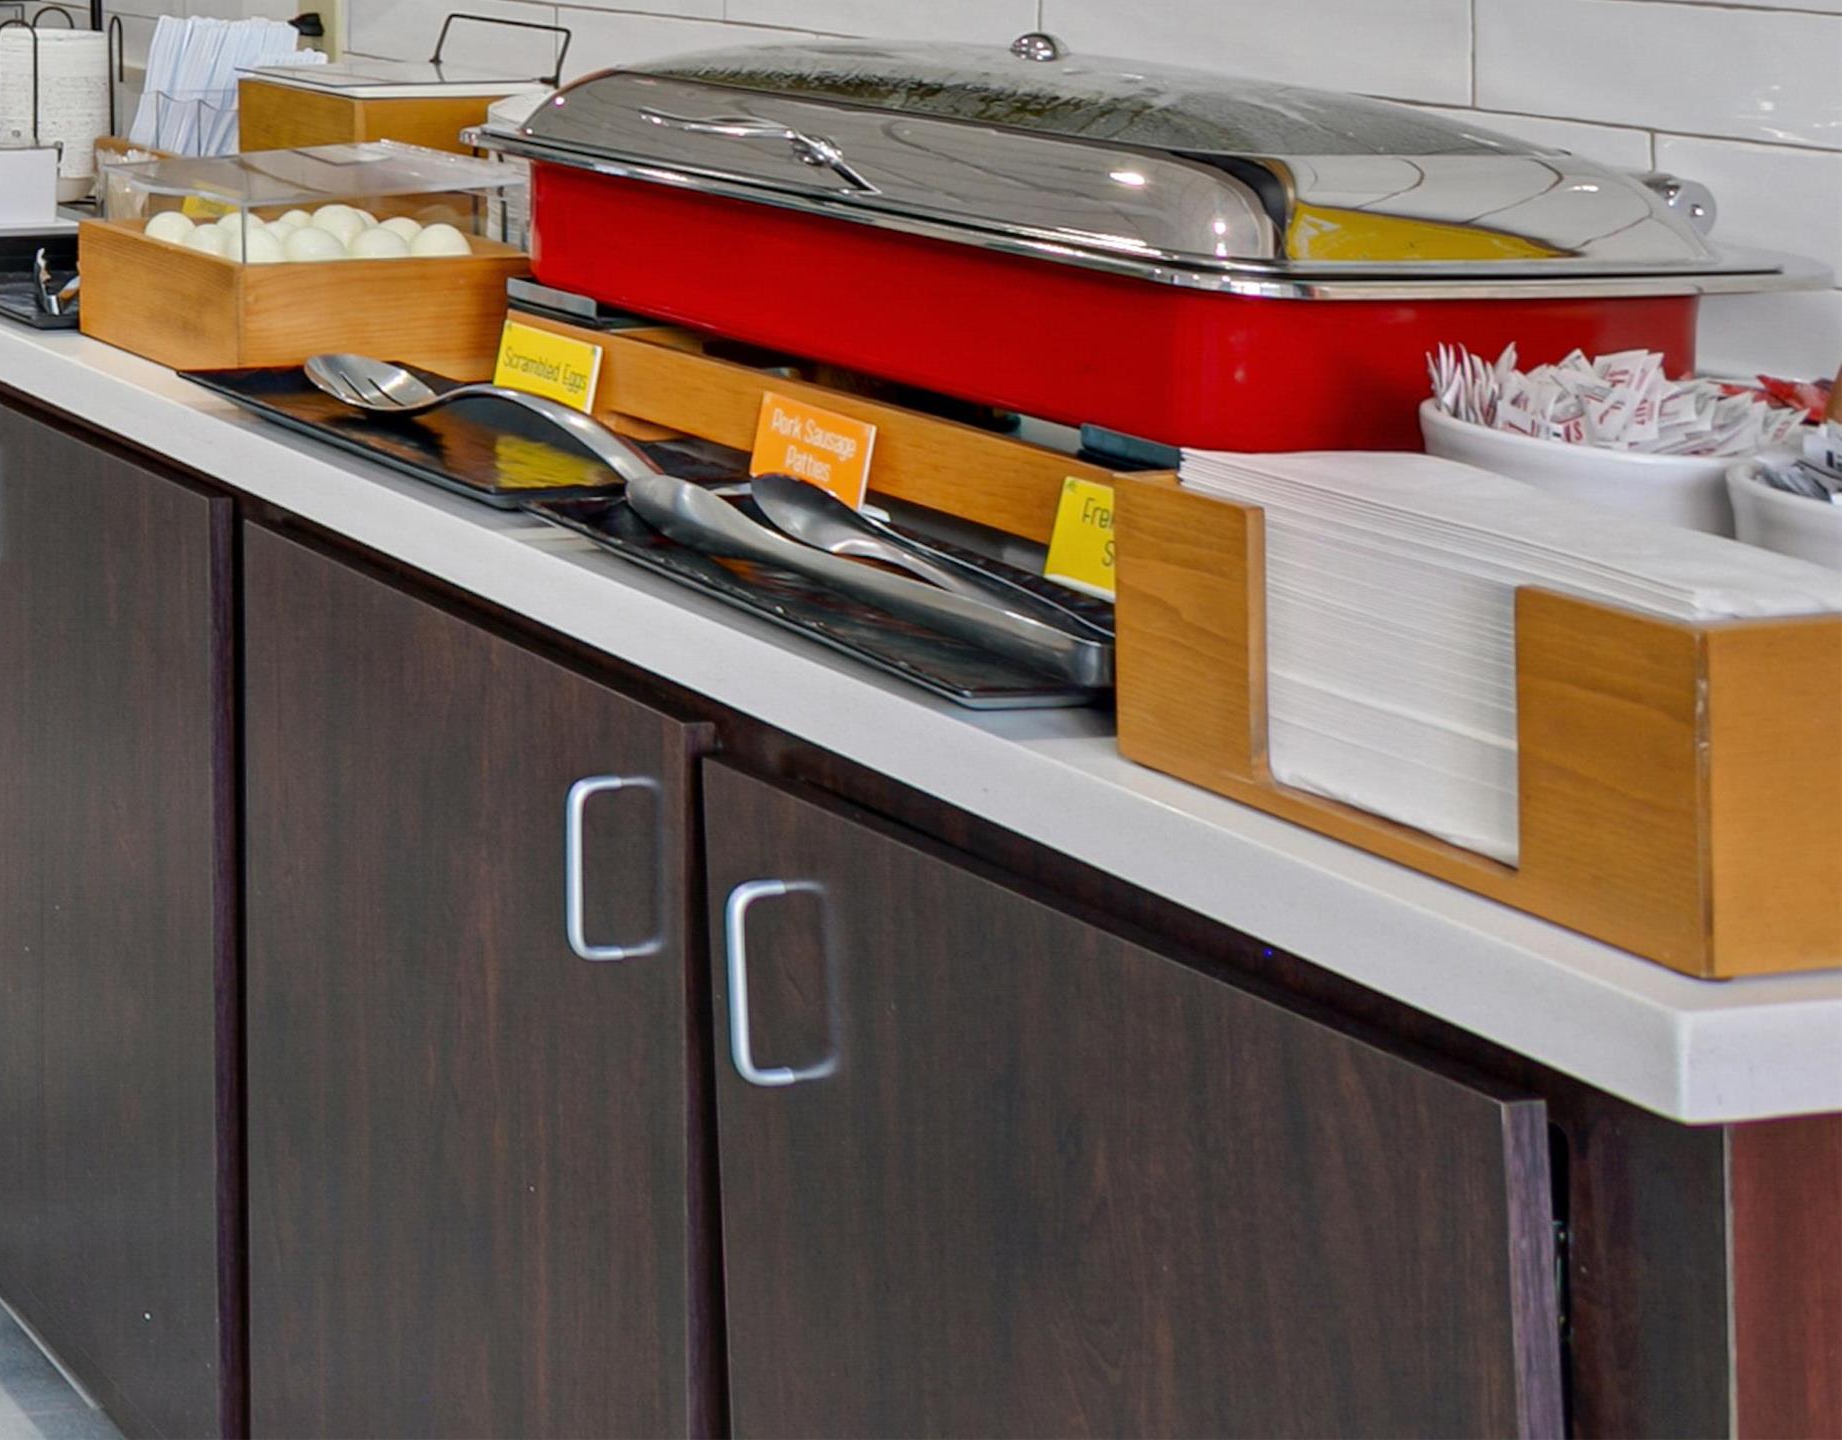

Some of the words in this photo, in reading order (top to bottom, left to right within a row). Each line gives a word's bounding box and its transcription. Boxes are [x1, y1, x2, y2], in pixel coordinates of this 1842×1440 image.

[503, 346, 561, 381] Scrambled
[562, 364, 588, 394] Eggs
[772, 408, 801, 438] Pork
[804, 419, 857, 462] Sausage
[785, 444, 831, 482] Patties
[1082, 497, 1114, 530] Fre
